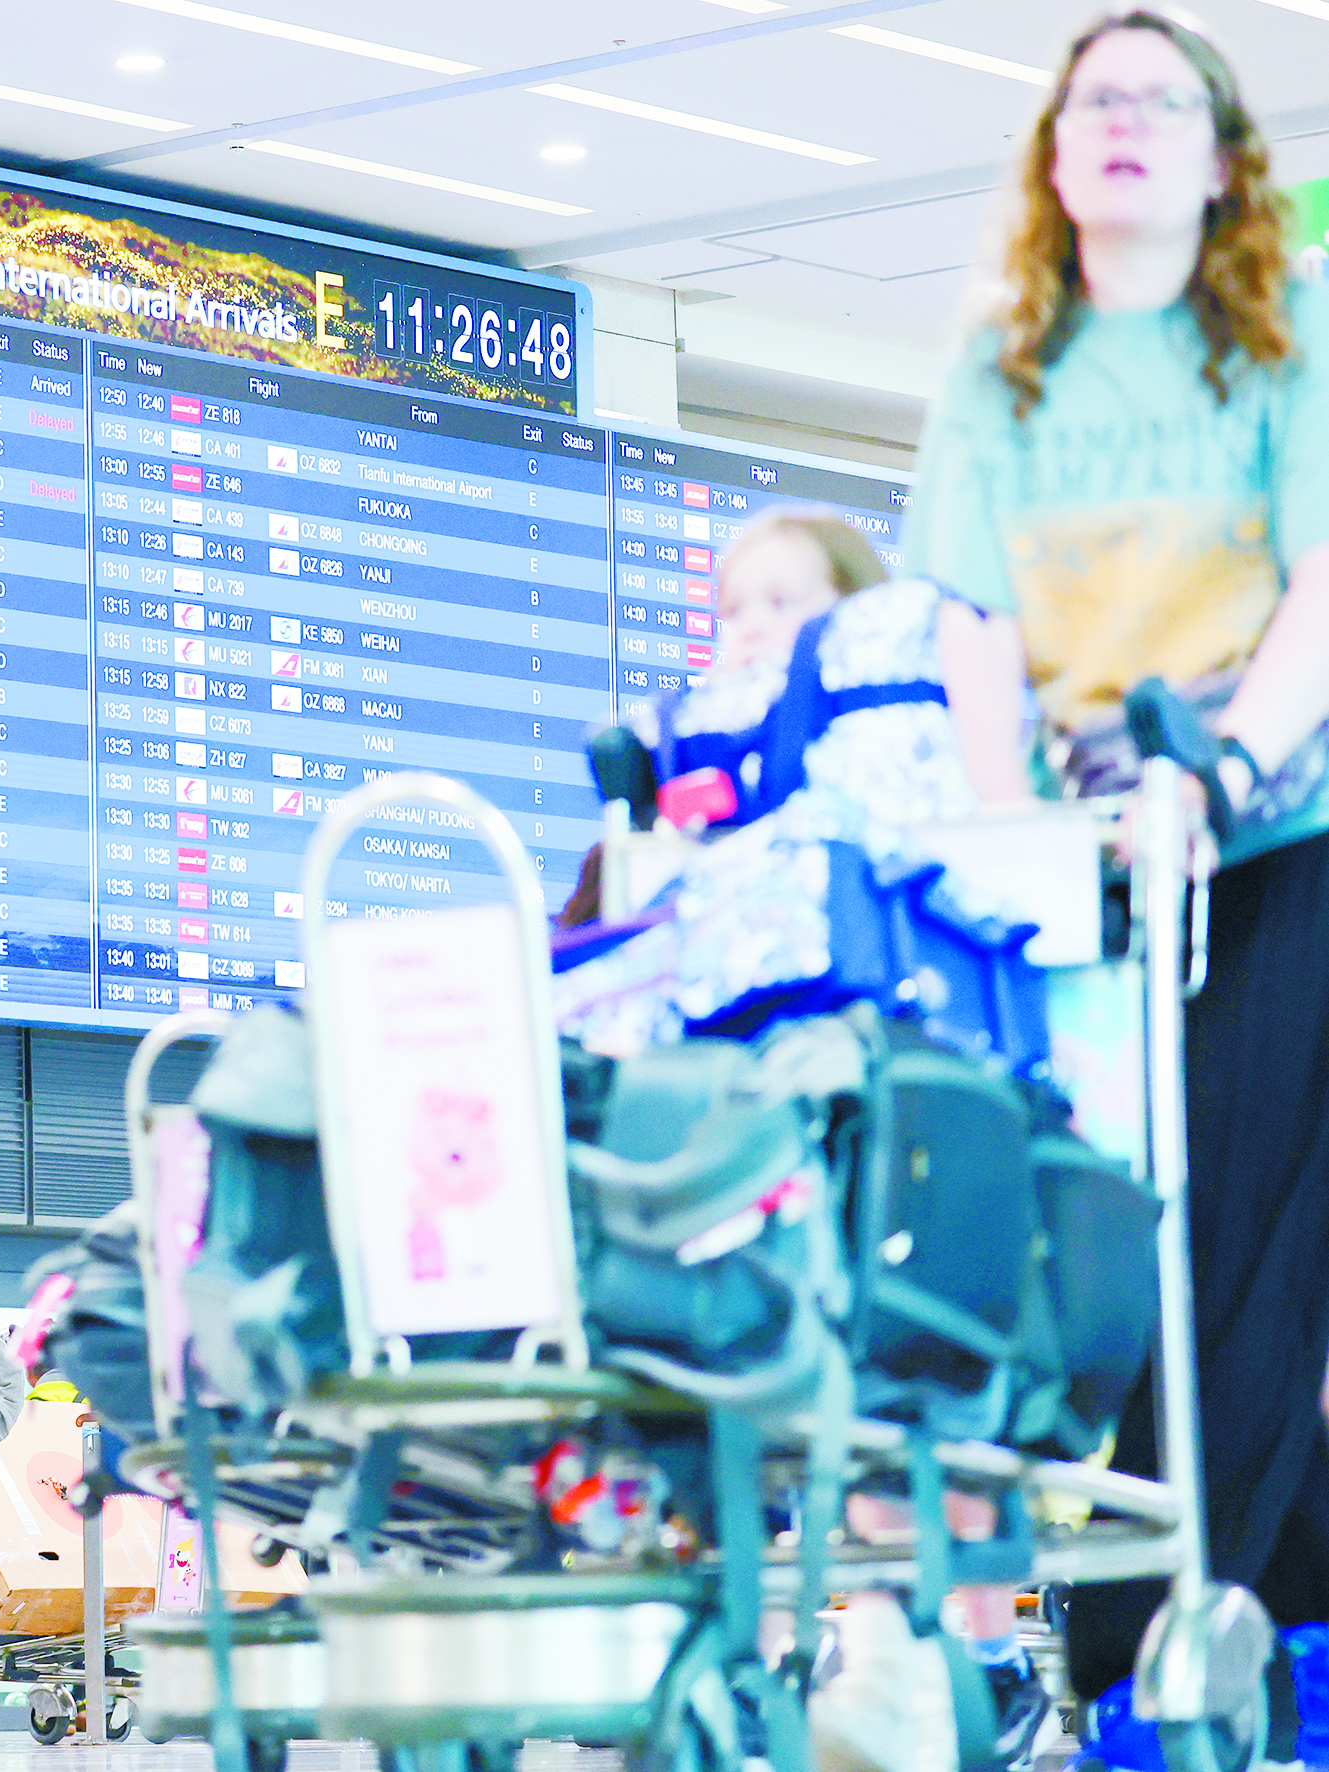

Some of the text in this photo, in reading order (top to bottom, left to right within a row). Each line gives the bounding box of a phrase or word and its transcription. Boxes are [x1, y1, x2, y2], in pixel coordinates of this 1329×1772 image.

[184, 288, 299, 343] Arrivals
[315, 270, 347, 349] E
[378, 291, 572, 380] 11:26:48
[32, 340, 69, 361] Status
[30, 375, 71, 397] Arrived
[98, 351, 594, 451] Time New Flight From Exit Status
[99, 386, 537, 475] 12:50 12:40 ZE 818 YANTAI C
[29, 479, 76, 504] Delayed
[99, 421, 538, 508] 12:55 12:46 CA 401 OZ 6832 Tianfu International Airport E
[619, 441, 914, 507] Time New Flight From
[620, 474, 891, 535] 13:45 13:45 7C 1404 FUKUOKA
[104, 807, 545, 871] 13:30 13:30 TW 302 OSAKA/ KANSAI C
[0, 938, 9, 956] E
